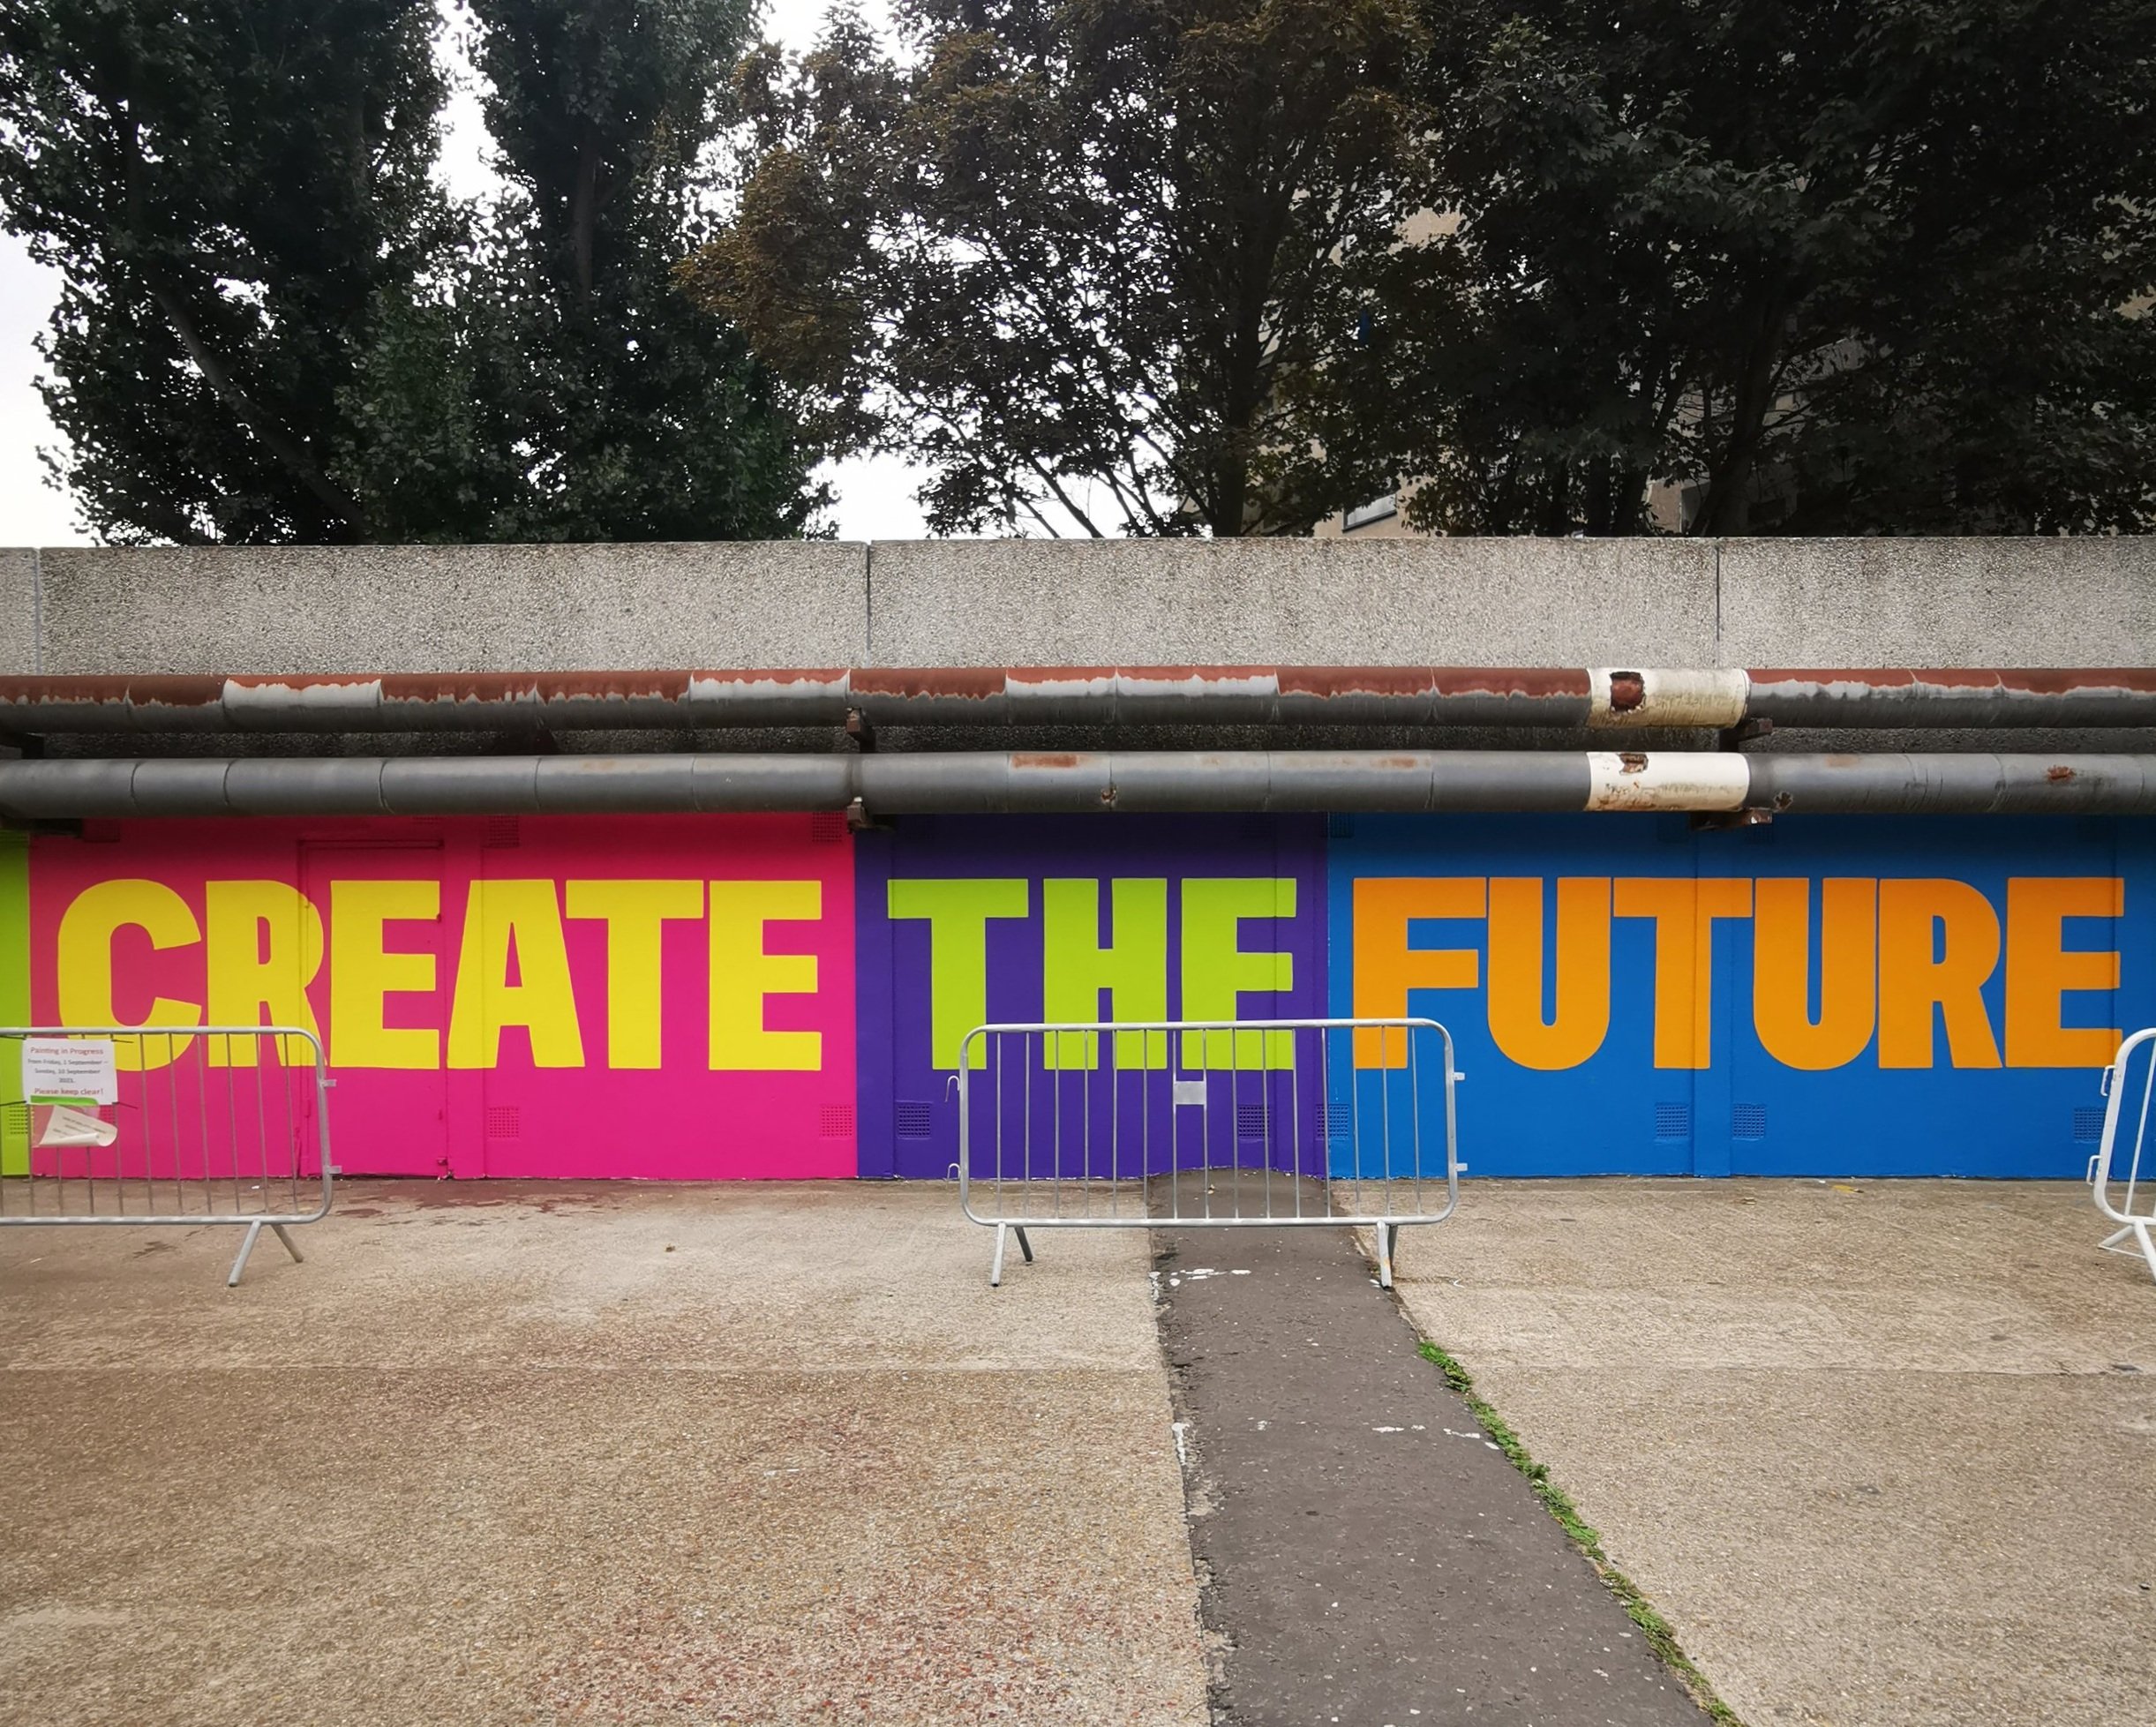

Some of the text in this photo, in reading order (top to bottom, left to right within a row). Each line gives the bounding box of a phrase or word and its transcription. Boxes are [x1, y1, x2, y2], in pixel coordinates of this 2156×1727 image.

[58, 877, 2125, 1070] CREATE THE FUTURE
[30, 1047, 59, 1055] Painting
